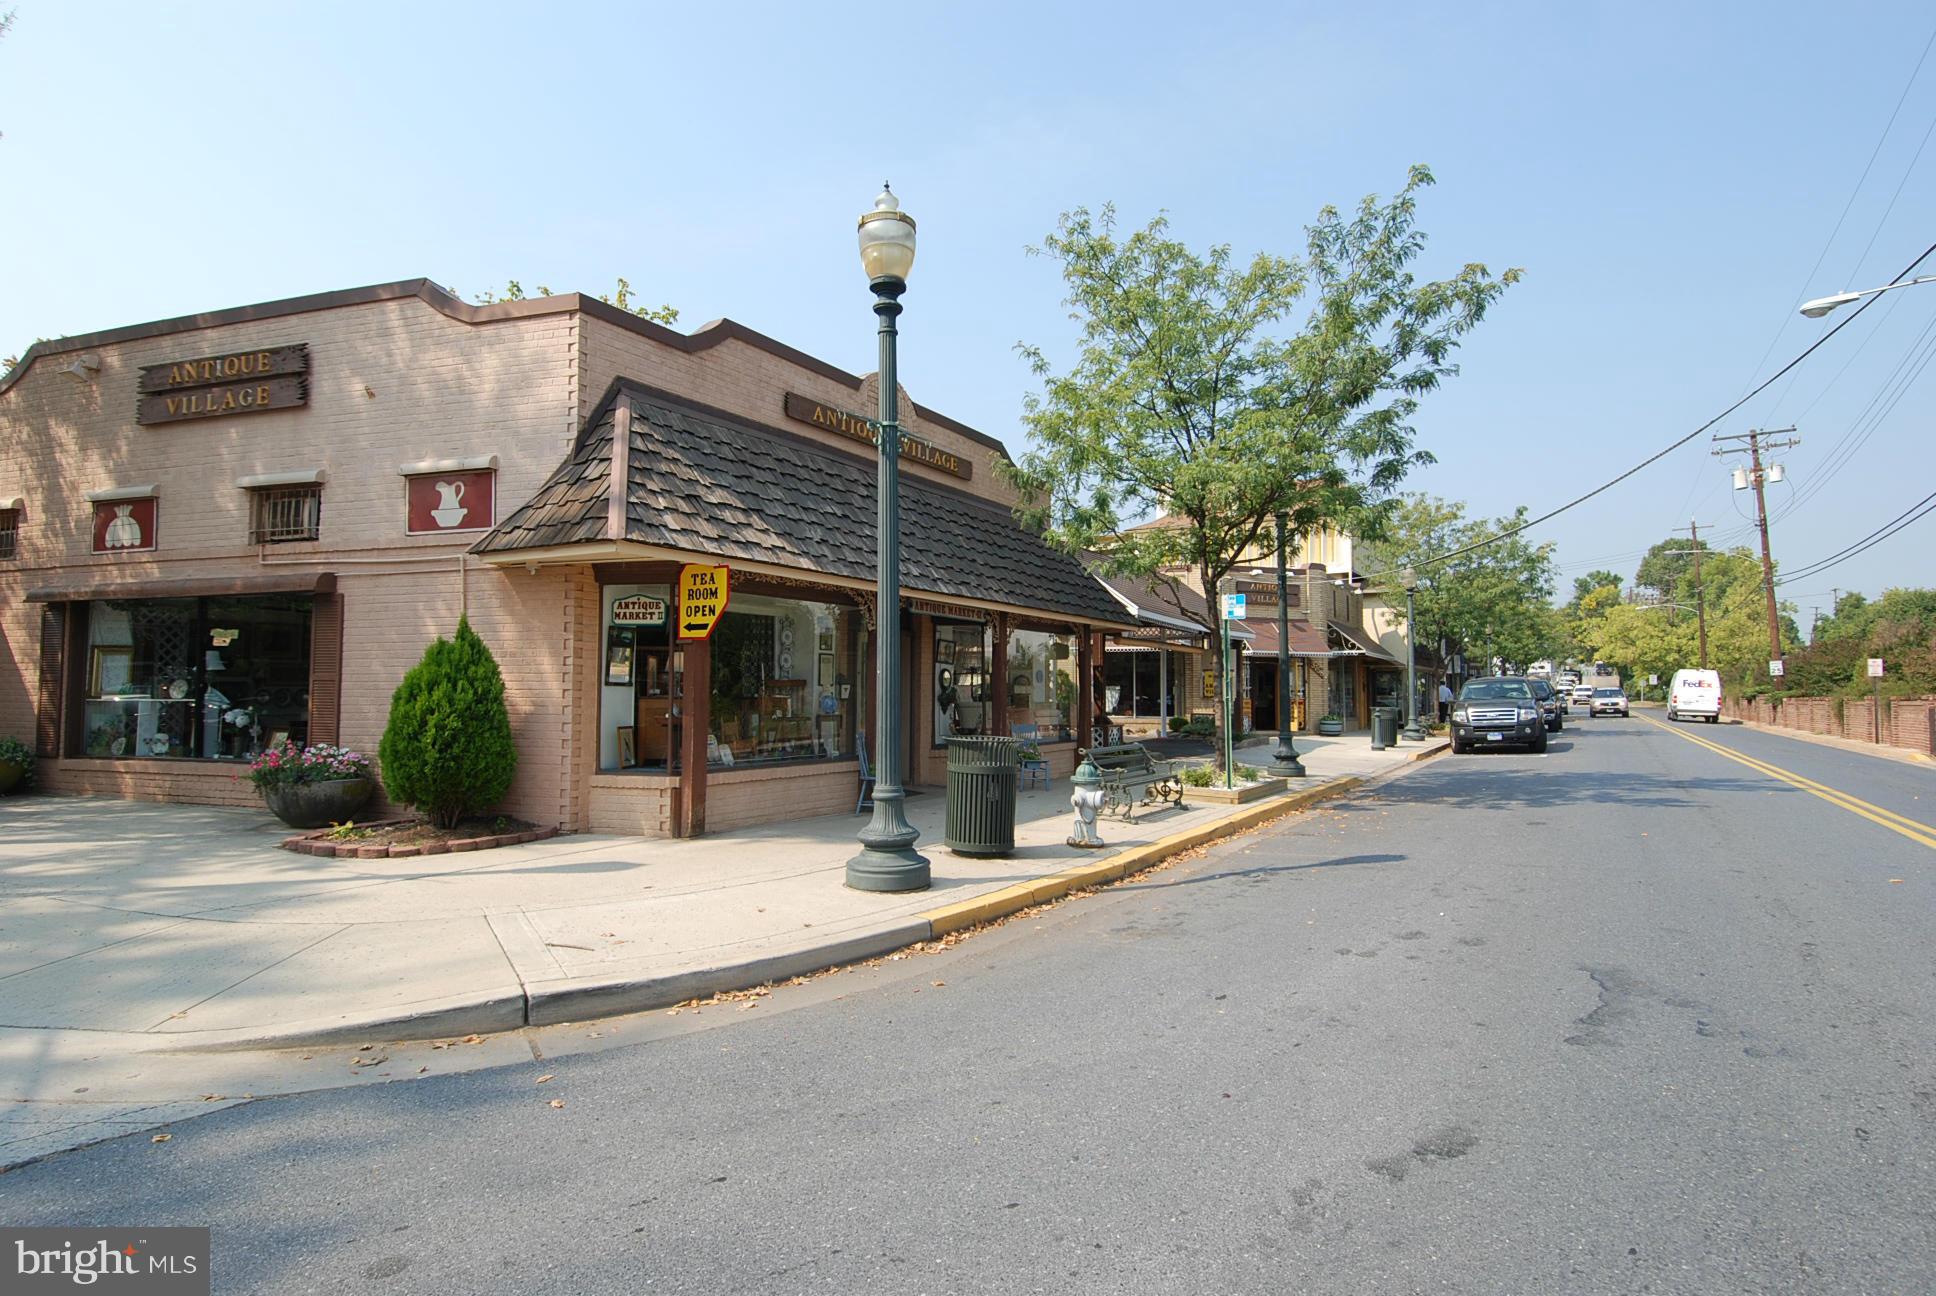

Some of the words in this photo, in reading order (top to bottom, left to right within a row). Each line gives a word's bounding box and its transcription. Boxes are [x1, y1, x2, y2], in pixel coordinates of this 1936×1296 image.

[167, 352, 273, 385] ANTIQUE
[166, 385, 271, 416] VILLAGE
[812, 406, 879, 440] ANTIQ
[902, 439, 959, 472] VILLAGE
[690, 572, 716, 586] TEA
[687, 587, 718, 600] ROOM
[1252, 594, 1279, 604] VILLA
[616, 600, 662, 611] ANTIQUE
[685, 604, 716, 618] OPEN
[614, 611, 655, 620] MARKET
[1682, 679, 1713, 689] FedEx
